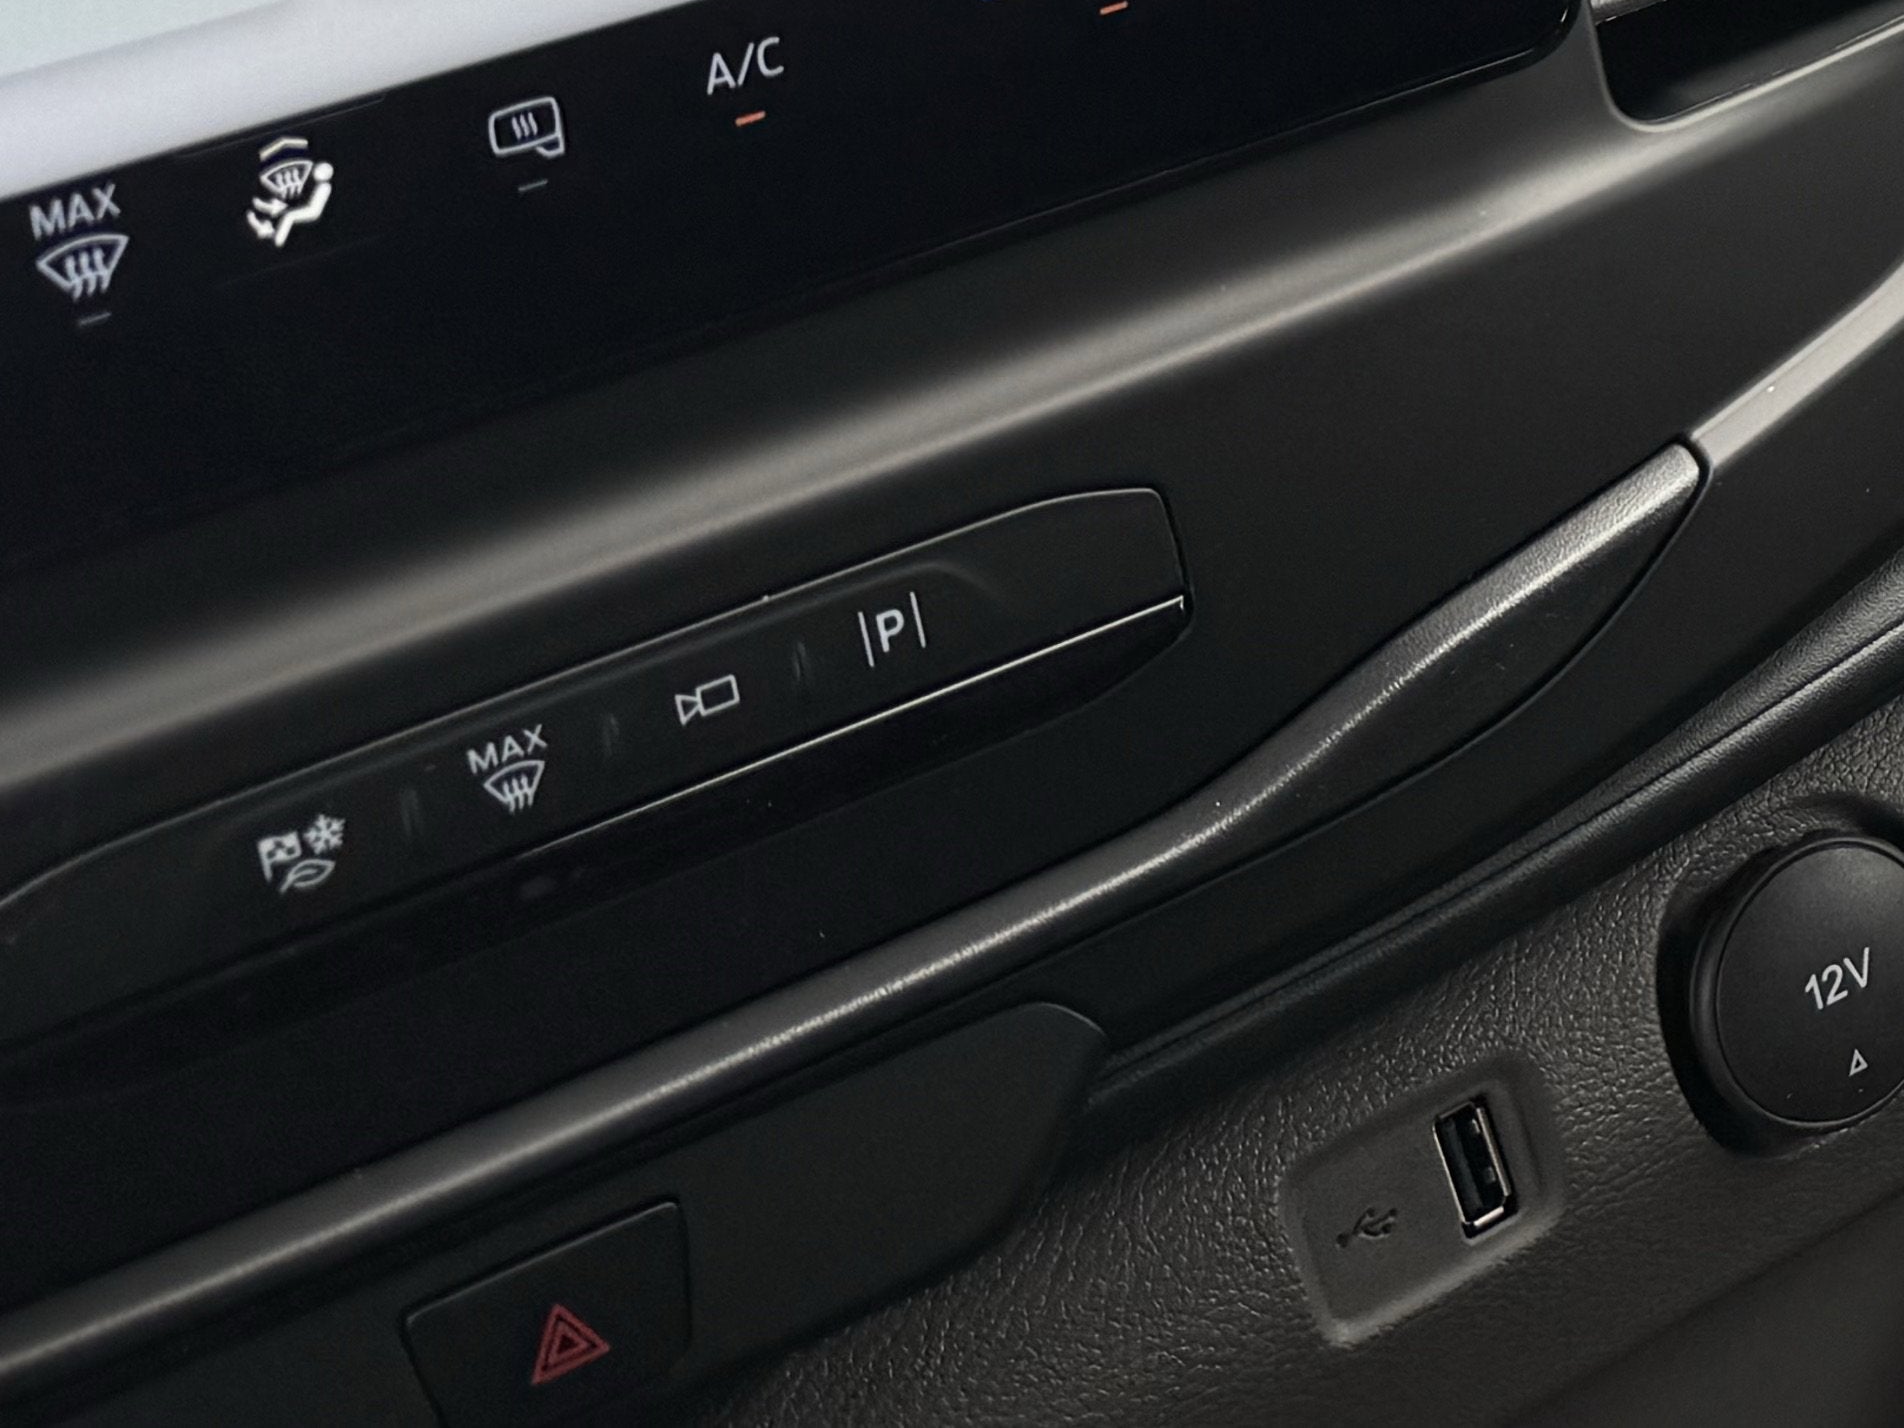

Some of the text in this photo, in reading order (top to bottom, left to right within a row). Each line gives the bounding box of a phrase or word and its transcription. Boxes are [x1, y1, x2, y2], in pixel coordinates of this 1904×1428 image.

[706, 36, 785, 96] A/C
[28, 182, 122, 243] MAX
[875, 609, 905, 653] P
[466, 722, 548, 775] MAX
[1804, 946, 1870, 1010] 12V
